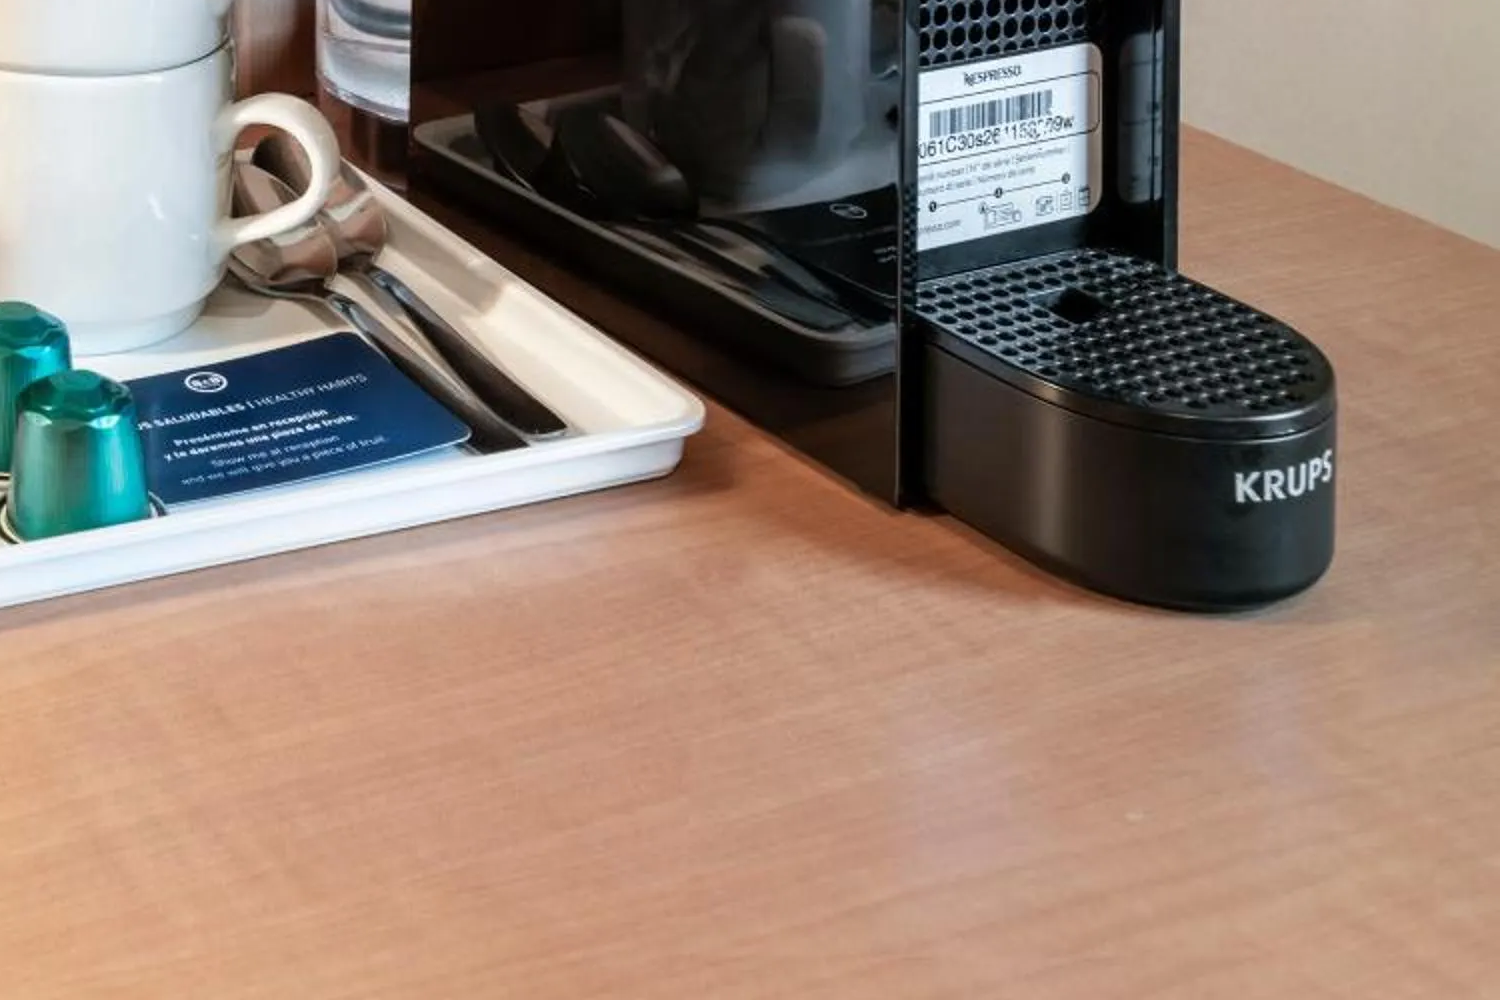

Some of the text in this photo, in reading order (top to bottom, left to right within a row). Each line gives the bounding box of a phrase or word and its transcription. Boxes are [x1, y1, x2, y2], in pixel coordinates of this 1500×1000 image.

[964, 64, 1023, 86] NESPRESSO
[153, 403, 246, 427] SALUDABLES
[1234, 448, 1333, 503] KRUPS
